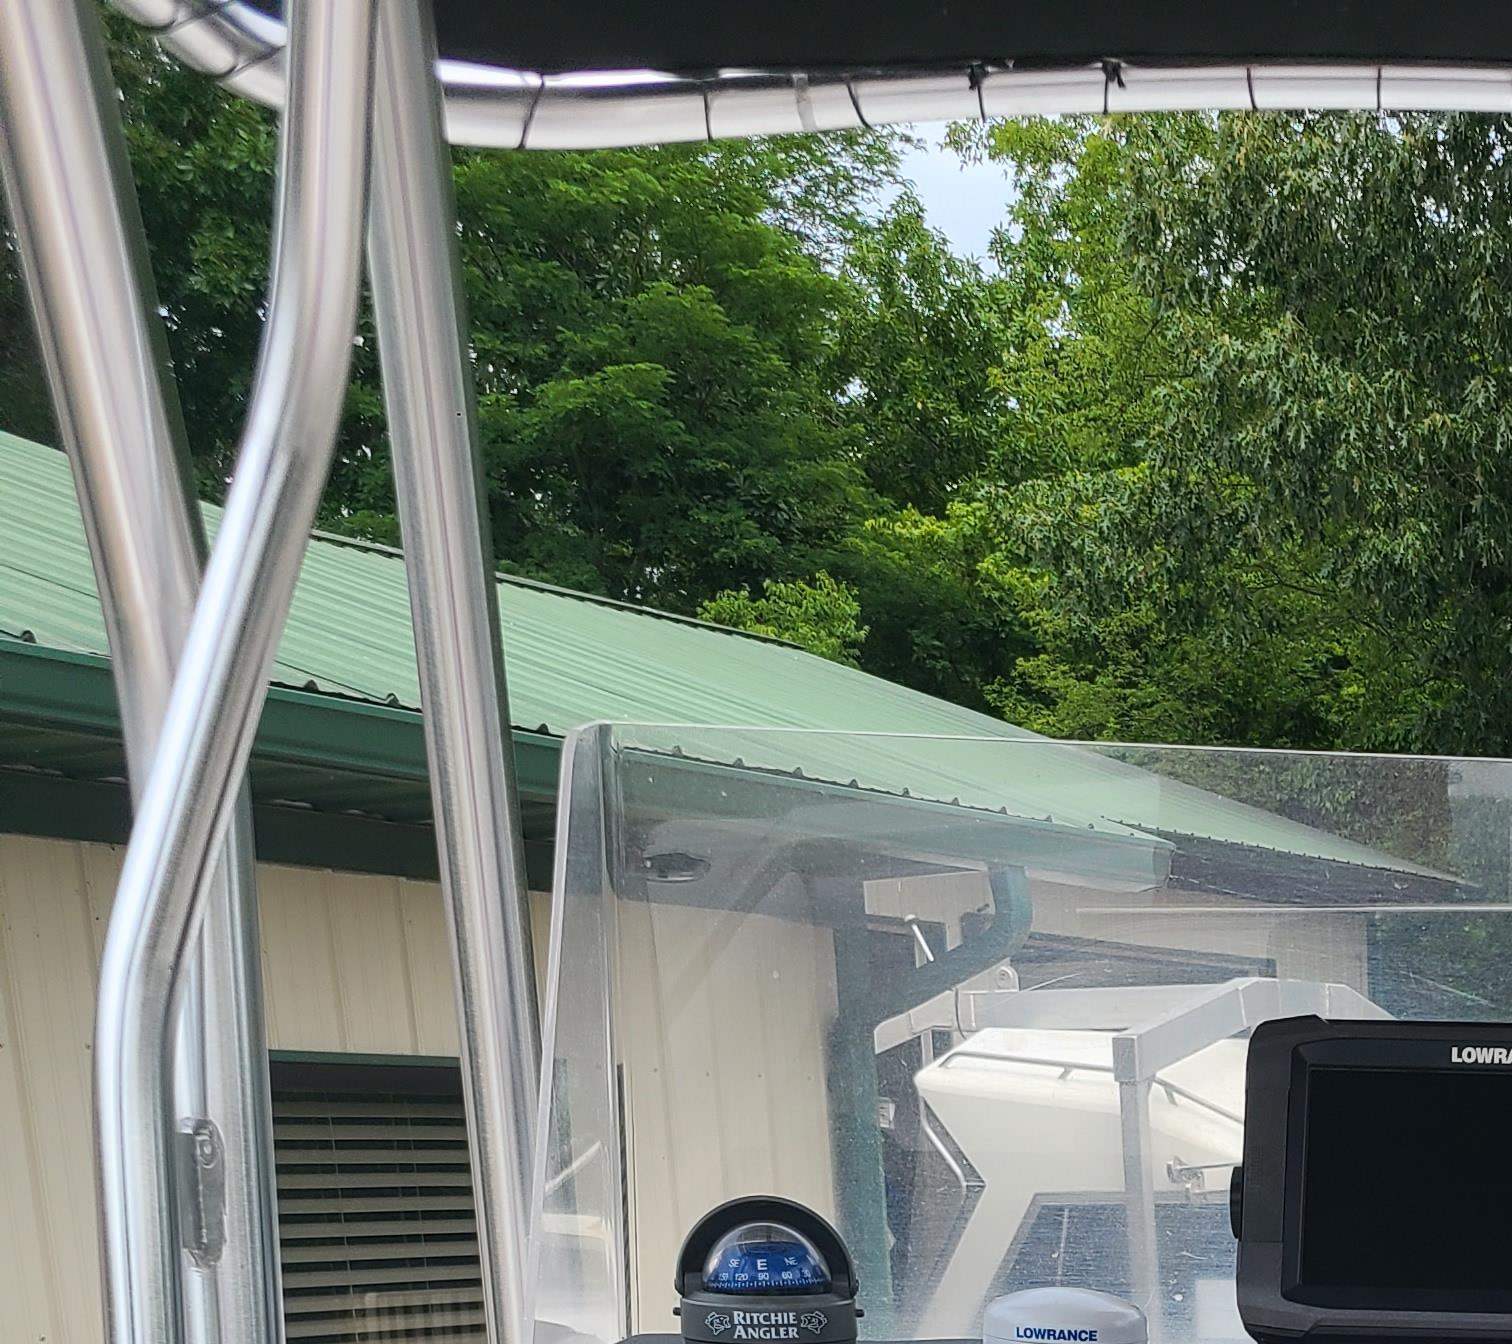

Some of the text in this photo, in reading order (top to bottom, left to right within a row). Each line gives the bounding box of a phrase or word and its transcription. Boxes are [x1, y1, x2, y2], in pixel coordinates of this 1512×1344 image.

[728, 1259, 741, 1268] SE
[757, 1259, 768, 1271] E
[784, 1257, 798, 1266] NE
[735, 1273, 749, 1281] 120
[757, 1272, 770, 1281] 90
[781, 1271, 793, 1280] 60
[733, 1310, 798, 1325] RITCHIE
[733, 1326, 800, 1340] ANGLER
[1016, 1326, 1098, 1342] LOWRANCE
